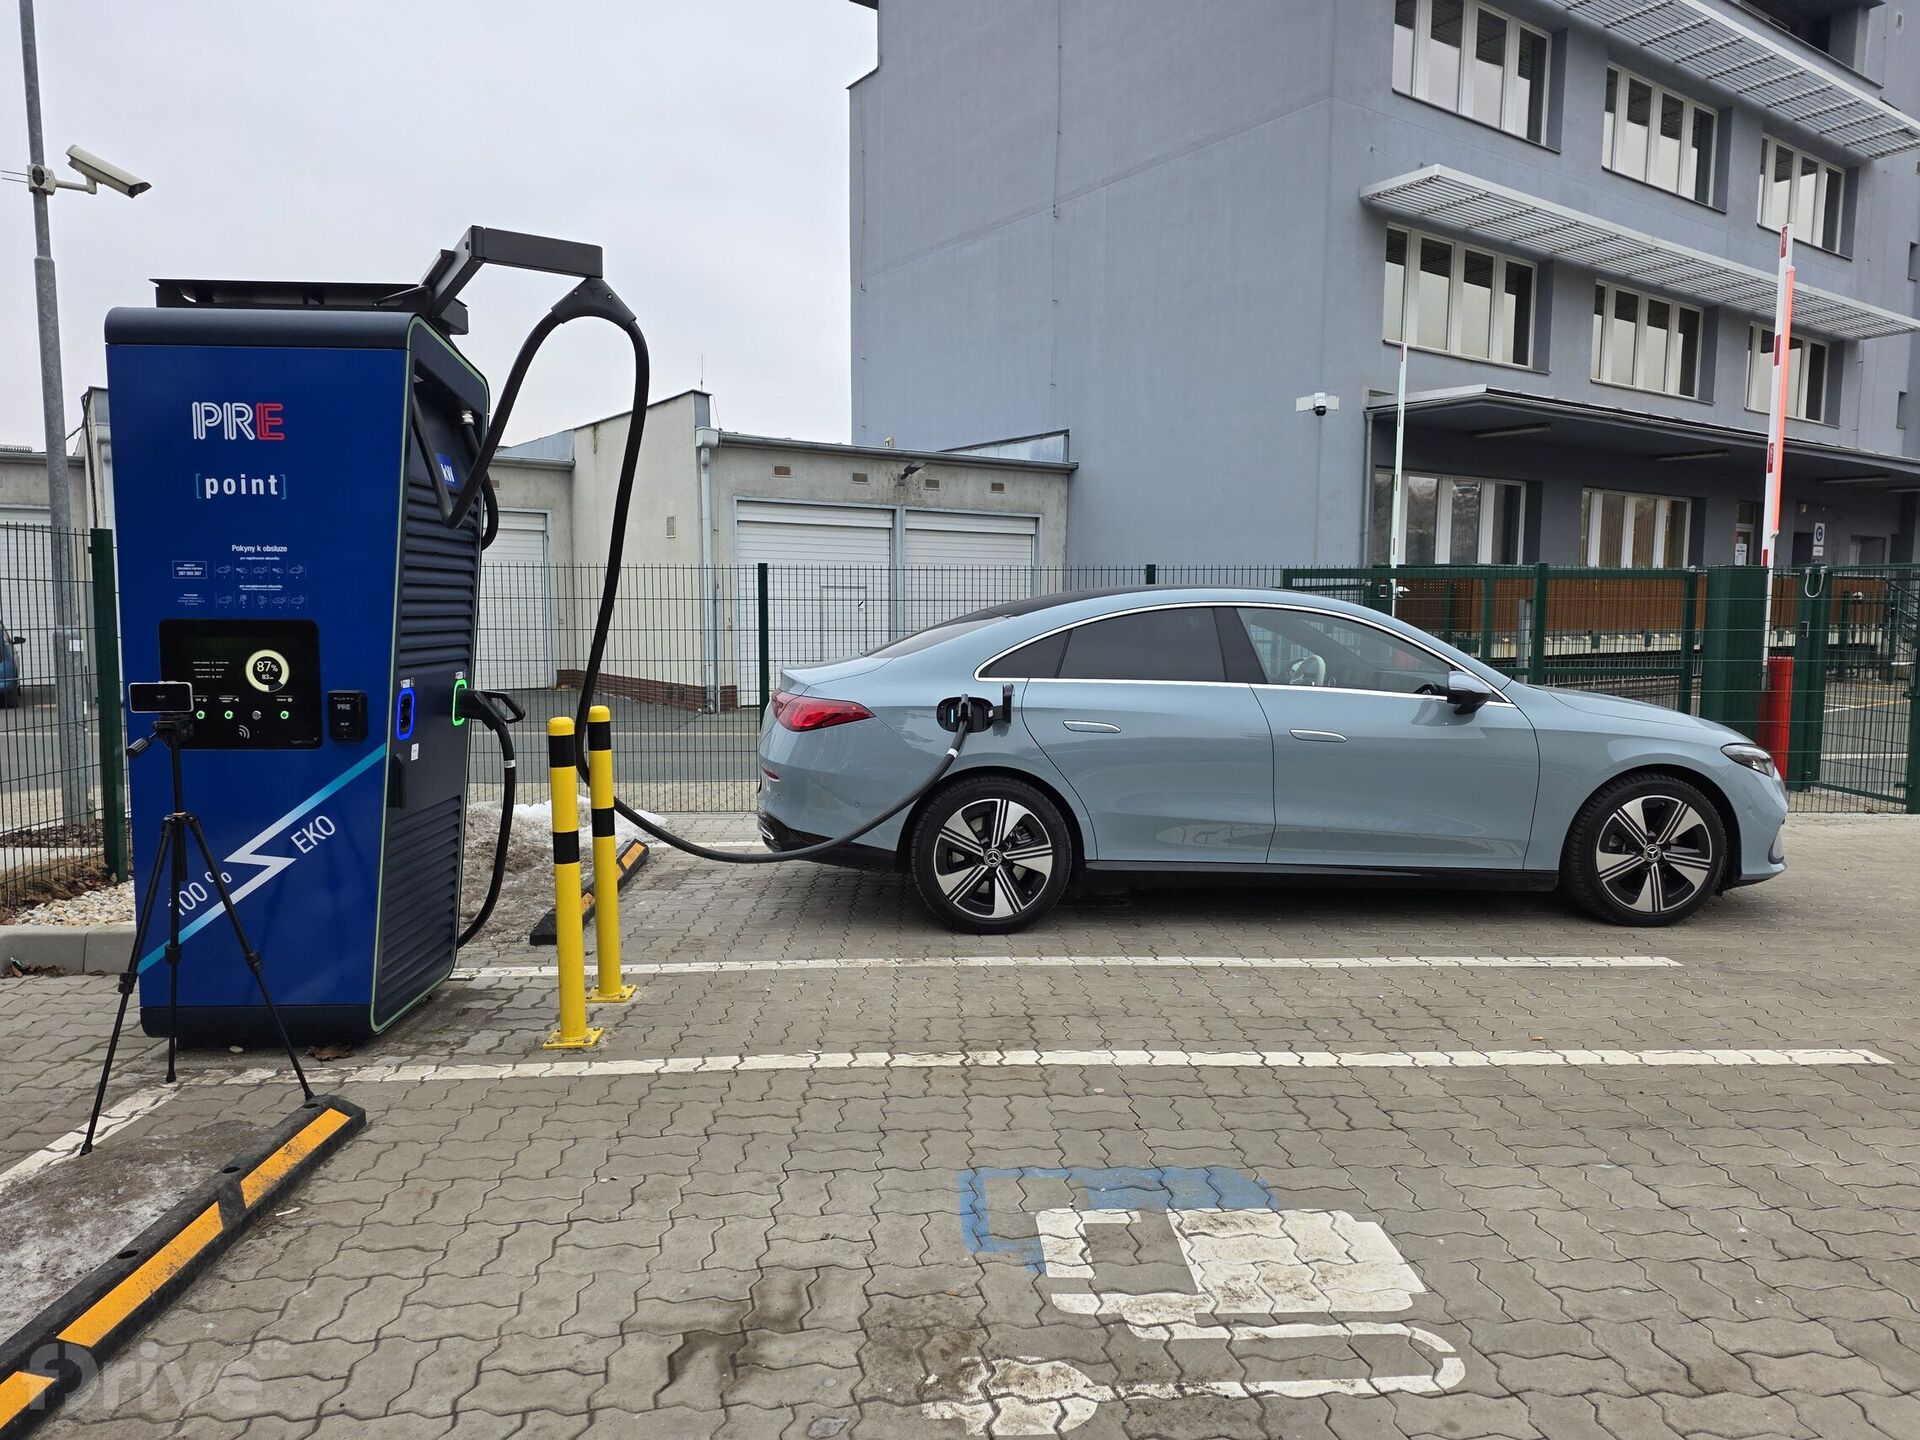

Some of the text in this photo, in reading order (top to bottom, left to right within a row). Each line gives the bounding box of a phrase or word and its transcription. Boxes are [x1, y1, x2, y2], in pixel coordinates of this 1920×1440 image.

[191, 401, 285, 441] PRE
[440, 463, 455, 482] kW
[231, 544, 288, 553] Pokyny k obsluze
[256, 661, 279, 672] 87%
[290, 815, 336, 854] EKO
